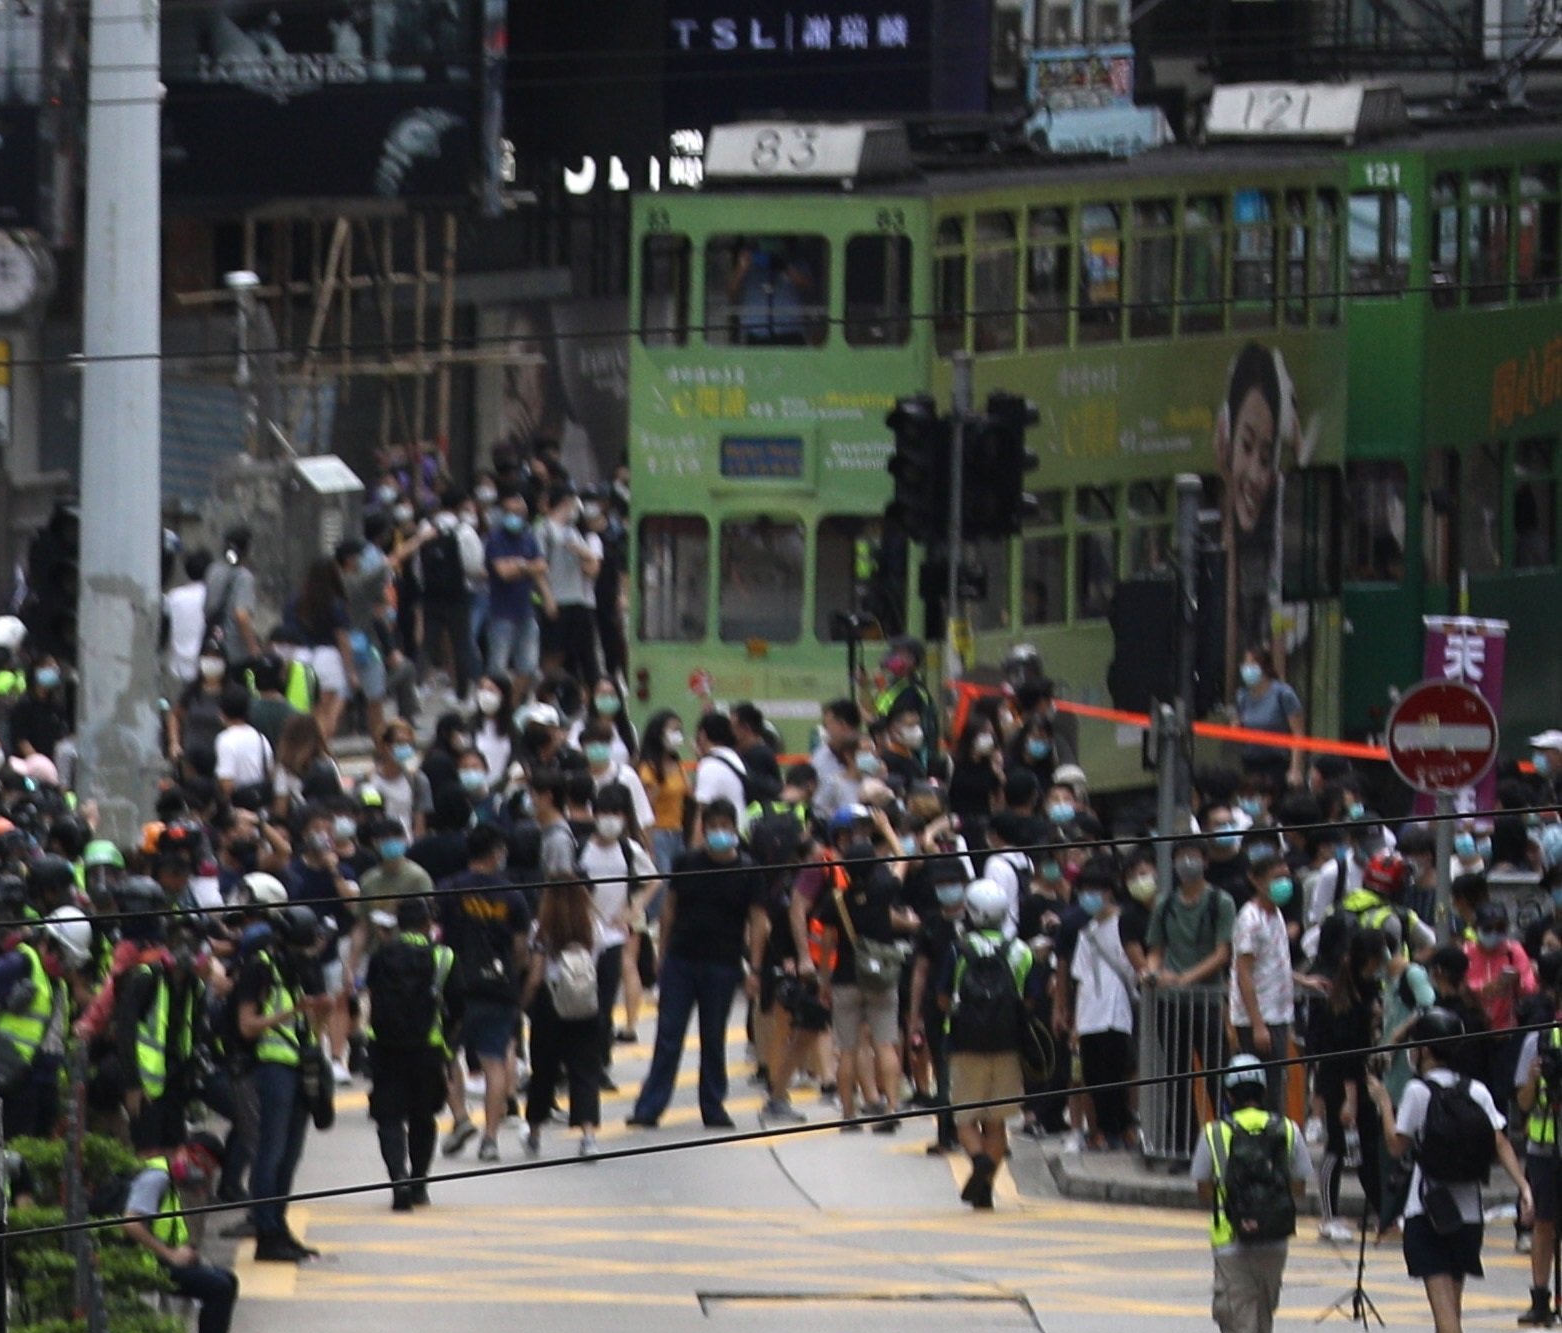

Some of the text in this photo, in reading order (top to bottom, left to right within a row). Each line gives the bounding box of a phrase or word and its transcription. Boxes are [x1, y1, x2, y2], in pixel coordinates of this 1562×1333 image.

[671, 17, 776, 50] TSL
[1244, 89, 1311, 130] 121
[752, 127, 817, 172] 83
[1364, 164, 1400, 186] 121
